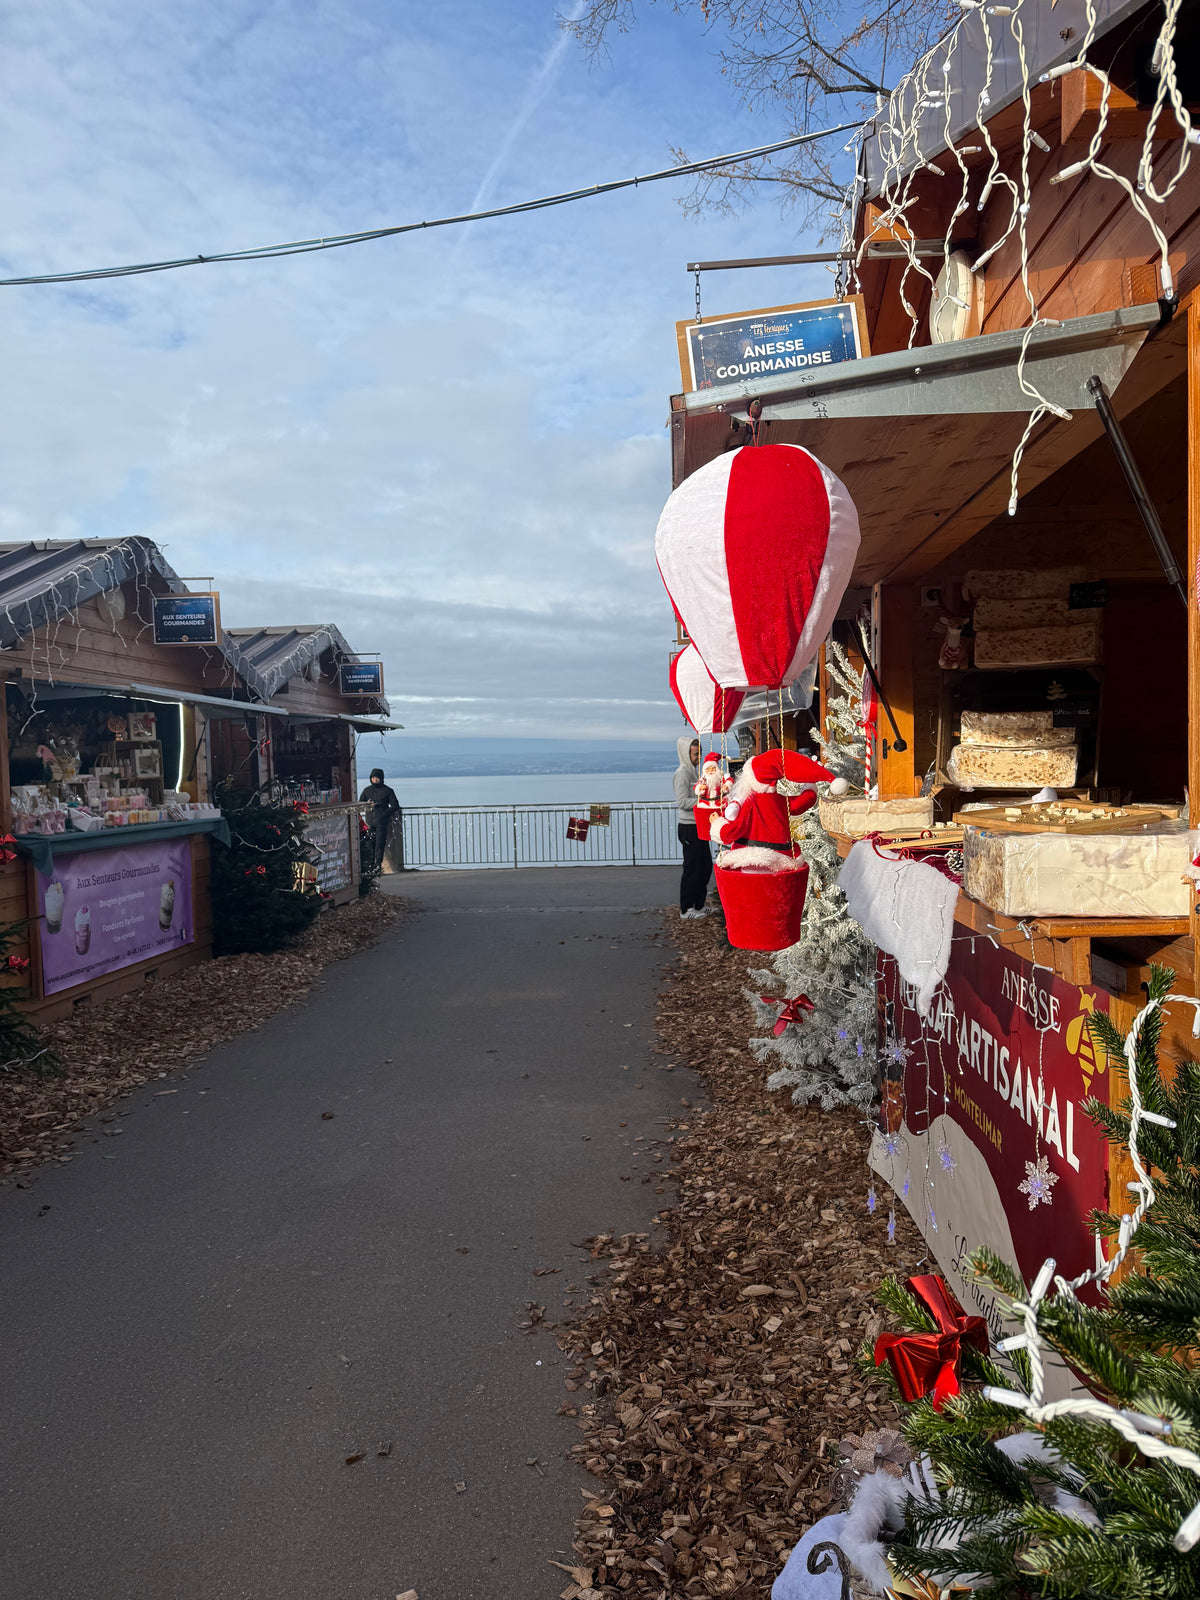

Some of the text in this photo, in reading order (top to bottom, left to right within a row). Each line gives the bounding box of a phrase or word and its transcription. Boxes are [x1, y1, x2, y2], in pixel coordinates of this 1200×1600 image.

[743, 338, 805, 359] ANESSE
[716, 350, 833, 379] GOURMANDISE
[175, 613, 206, 621] SENTEURS
[77, 878, 92, 889] Aux
[91, 871, 121, 885] Senteurs
[122, 863, 160, 879] Gourmandes
[1001, 966, 1062, 1034] ANESSE
[958, 1010, 1080, 1174] ARTISANAL
[954, 1081, 1002, 1154] MONTELIMAR
